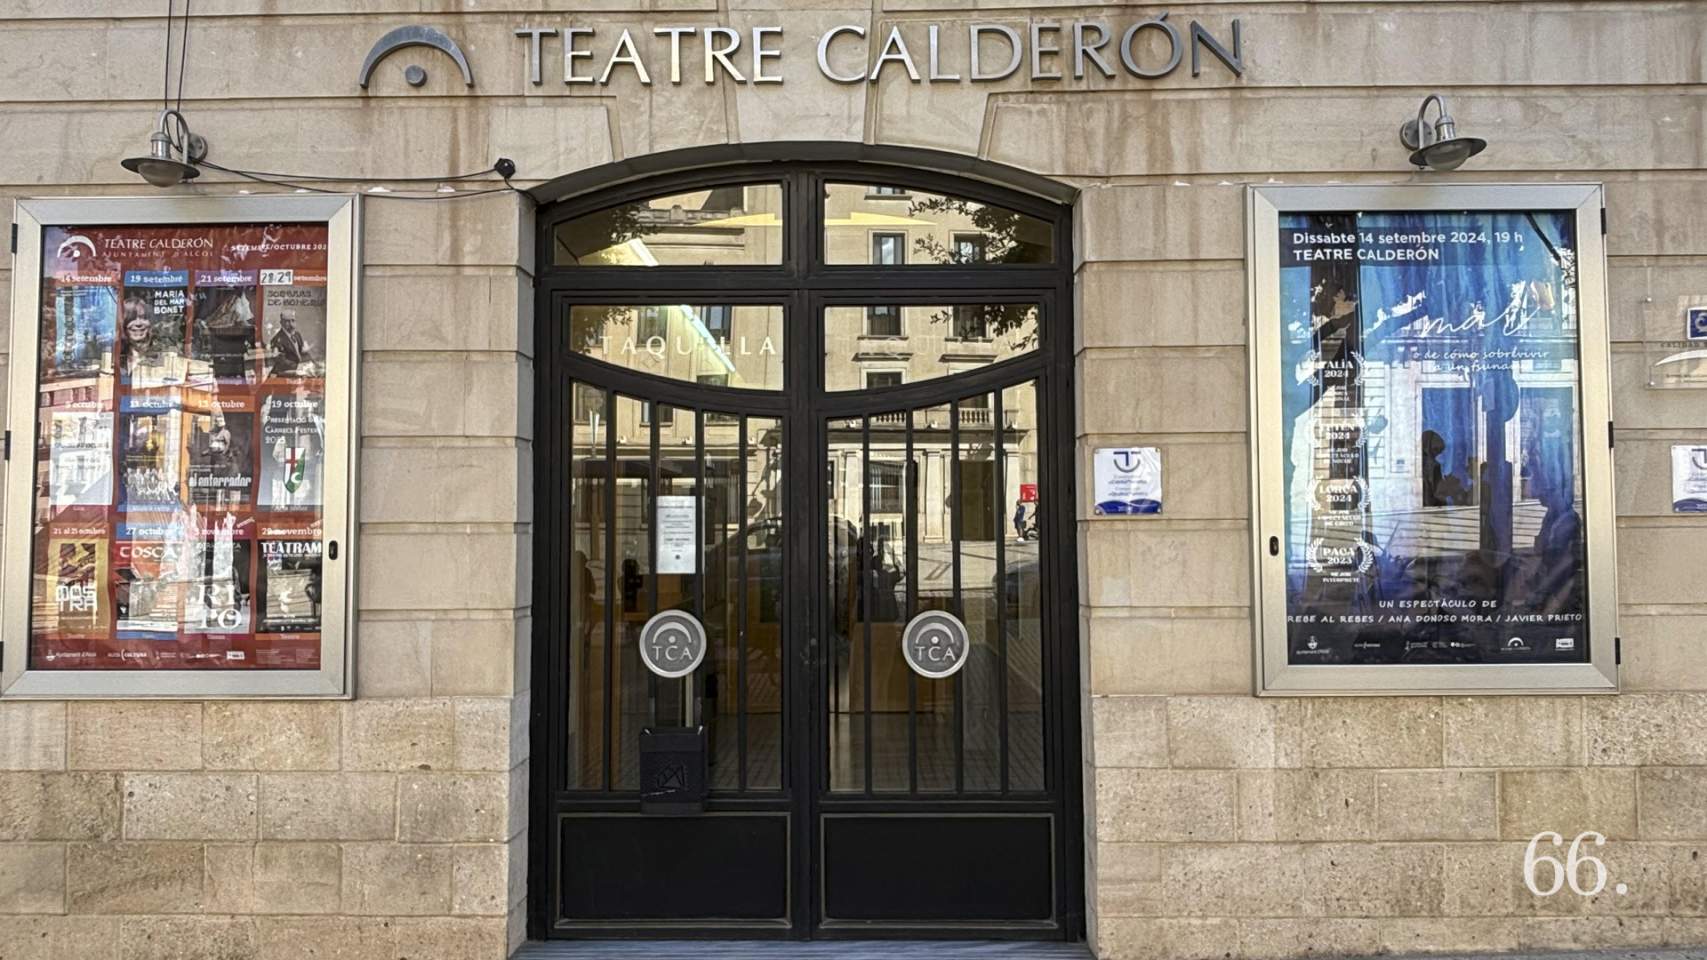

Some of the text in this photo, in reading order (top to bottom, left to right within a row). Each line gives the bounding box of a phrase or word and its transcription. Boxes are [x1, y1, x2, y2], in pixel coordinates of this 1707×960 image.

[514, 11, 1246, 86] TEATRE CALDERÓN
[104, 235, 214, 249] TEATRE CALDERÓN
[1293, 231, 1523, 245] Dissabte 14 setembre 2024, 19 h
[1293, 247, 1440, 261] TEATRE CALDERÓN
[72, 274, 113, 283] setembre
[130, 274, 183, 283] 19 setembre
[200, 274, 253, 283] 21 setembre
[155, 290, 185, 298] MARIA
[154, 305, 184, 314] BONET
[599, 335, 776, 360] TAQULLA
[1424, 348, 1441, 359] de
[1482, 345, 1550, 360] sobrevivir
[1323, 369, 1349, 378] 2024
[211, 399, 246, 409] octubre
[271, 400, 319, 410] 19 octubre
[1326, 494, 1353, 502] 2024
[126, 528, 136, 536] 27
[1378, 598, 1497, 608] UN ESPECTÁCULO DE
[1287, 615, 1317, 623] REBE
[1321, 615, 1336, 623] AL
[1388, 615, 1412, 623] ANA
[1415, 614, 1458, 623] DONOSO
[1461, 614, 1493, 623] MORA
[1504, 614, 1544, 622] JAVIER
[1547, 613, 1583, 622] PRIETO
[651, 645, 693, 662] TCA
[914, 645, 957, 662] TCA
